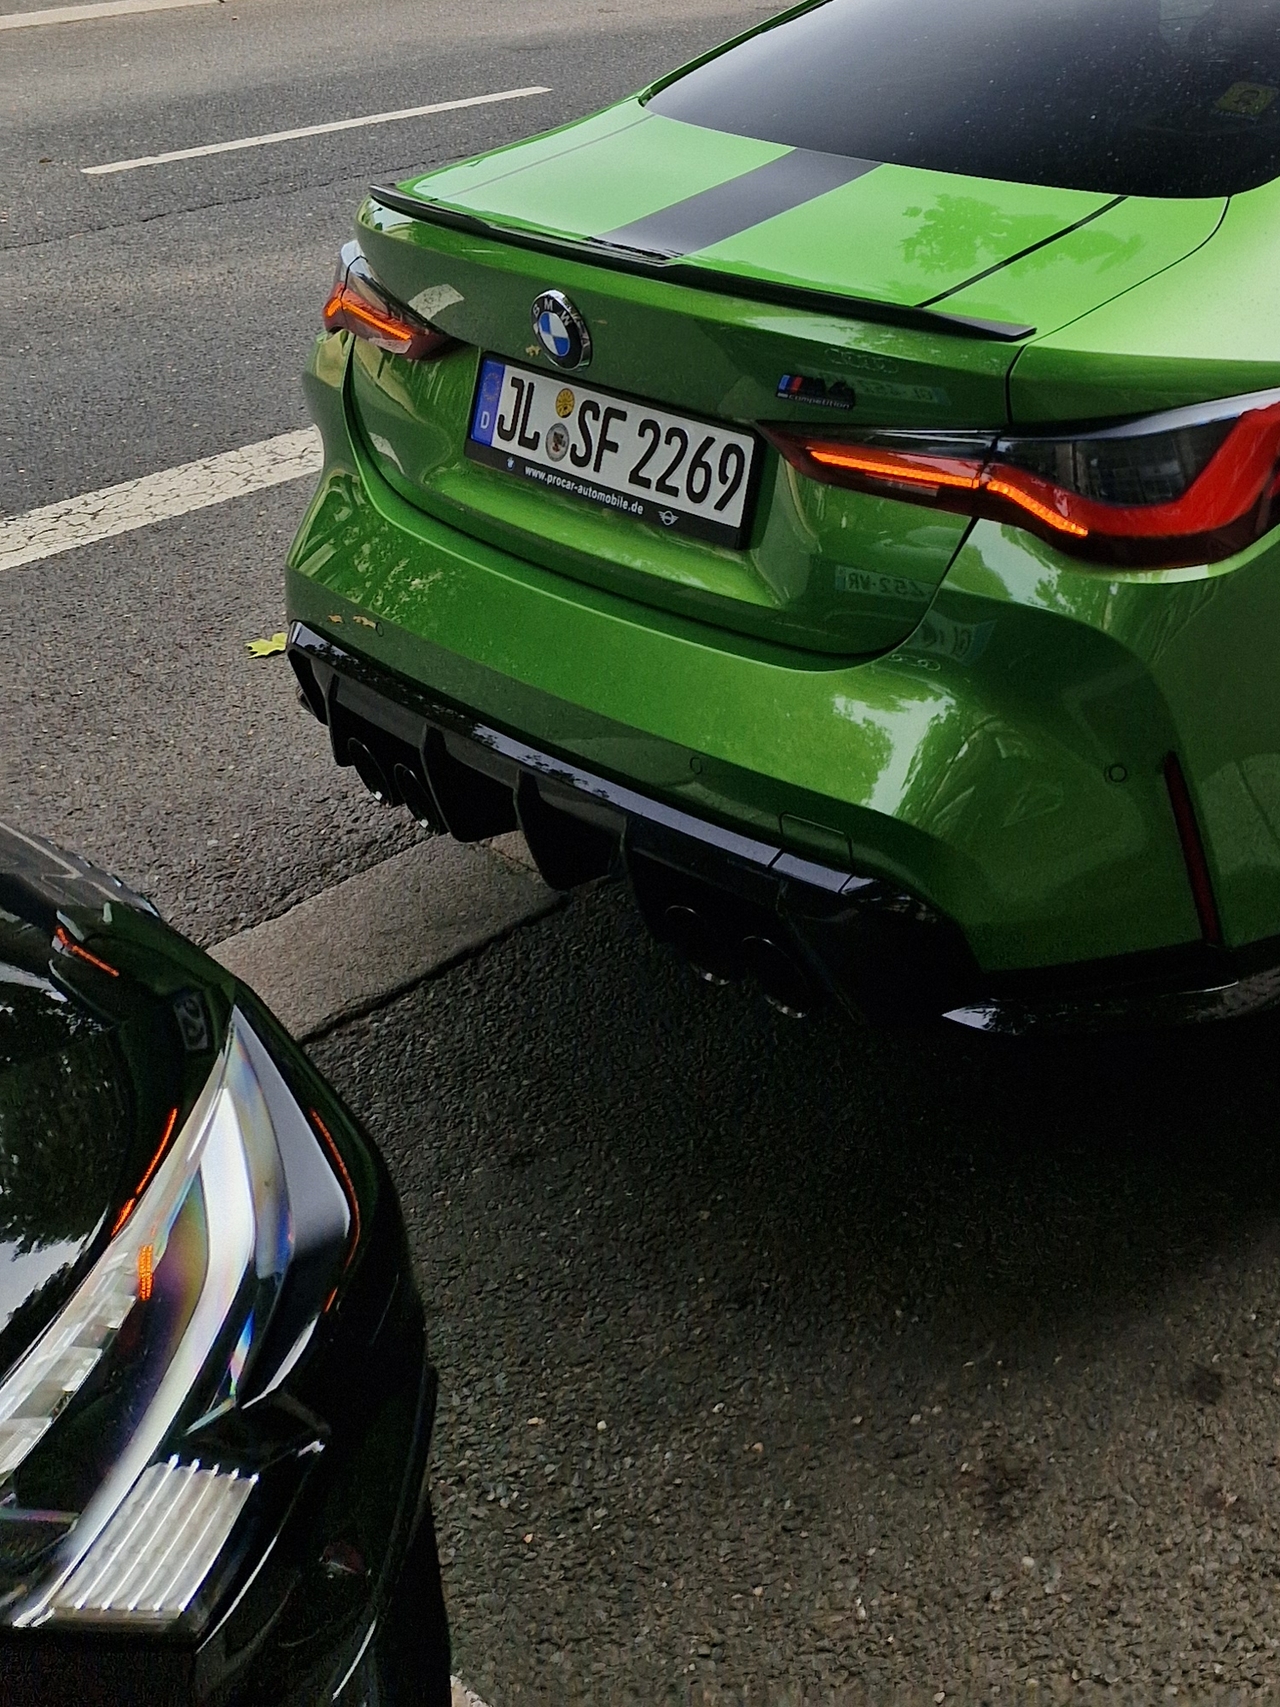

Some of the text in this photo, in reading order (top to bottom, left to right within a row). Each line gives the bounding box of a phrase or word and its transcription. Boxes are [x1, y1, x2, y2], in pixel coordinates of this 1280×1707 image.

[532, 297, 573, 327] BMW
[480, 410, 491, 430] D
[497, 376, 746, 512] JL SF 2269
[524, 465, 644, 515] www.procar-automobile.de
